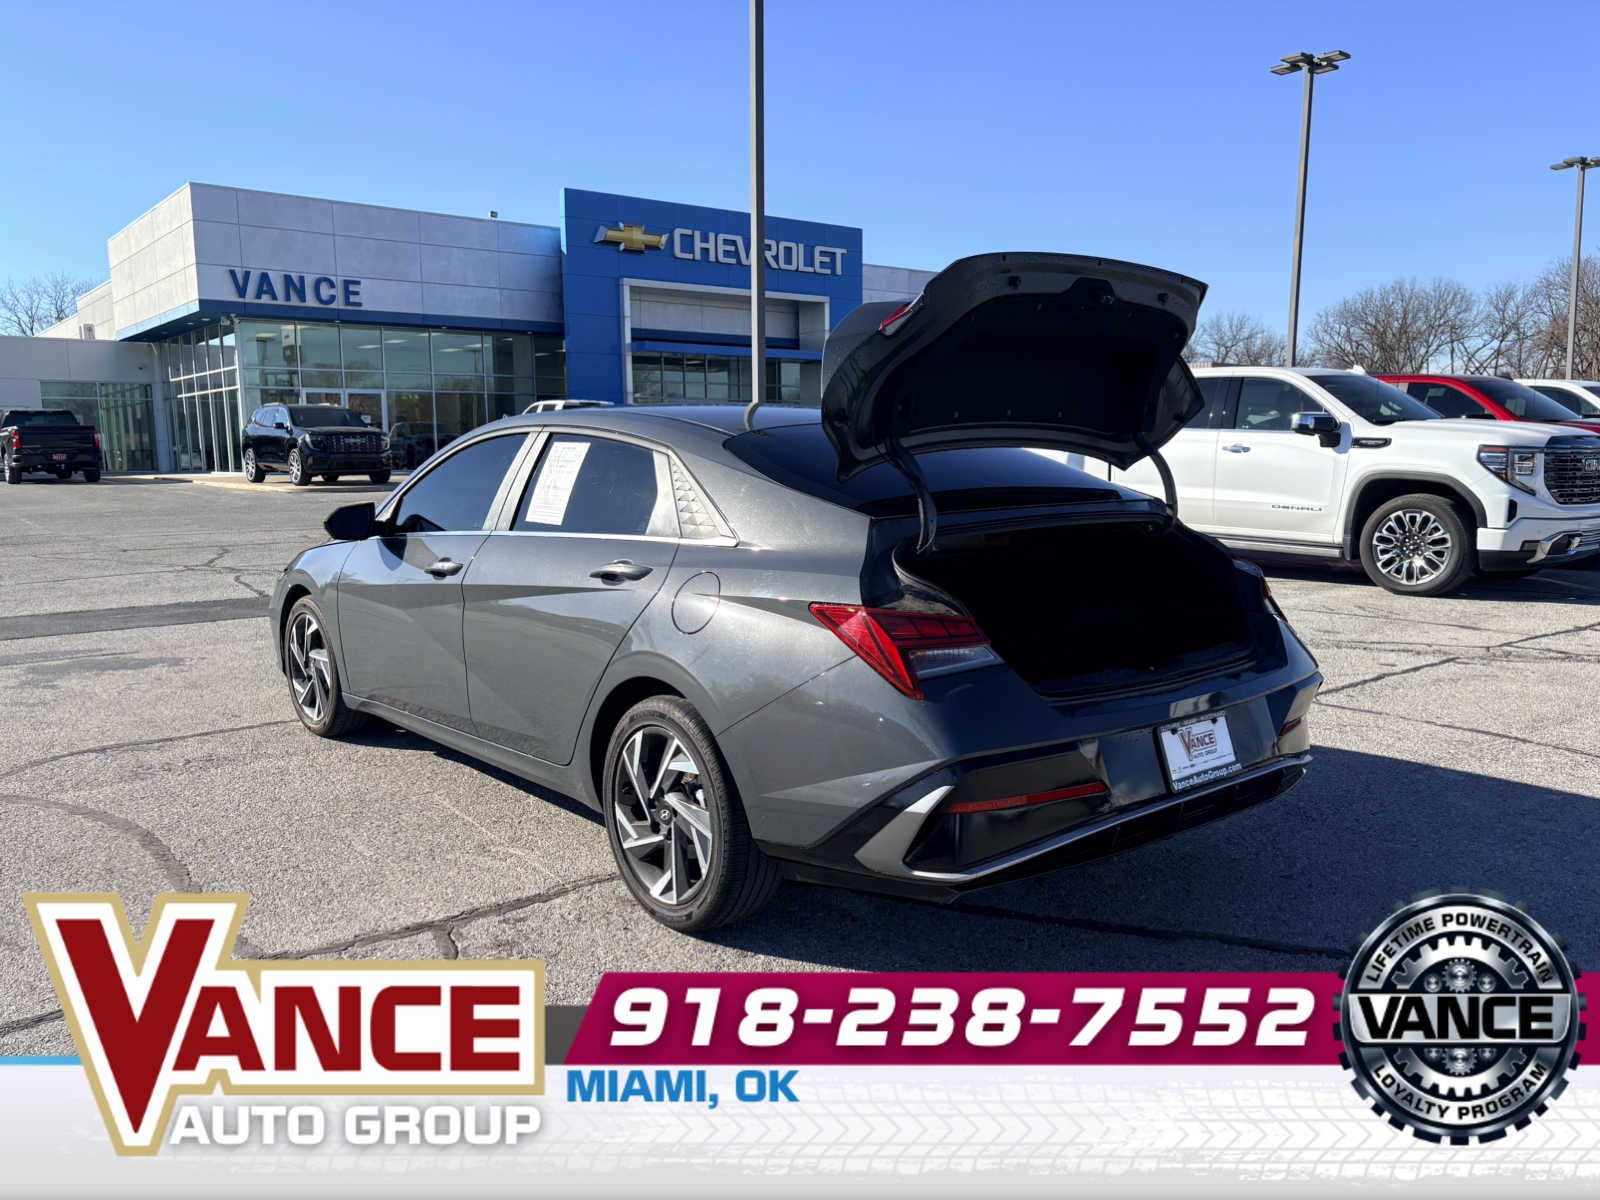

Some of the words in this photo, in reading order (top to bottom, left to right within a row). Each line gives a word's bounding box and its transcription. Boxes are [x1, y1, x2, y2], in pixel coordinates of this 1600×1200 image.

[673, 227, 848, 276] CHEVROLET
[229, 268, 363, 308] VANCE
[1178, 728, 1216, 757] VANCE
